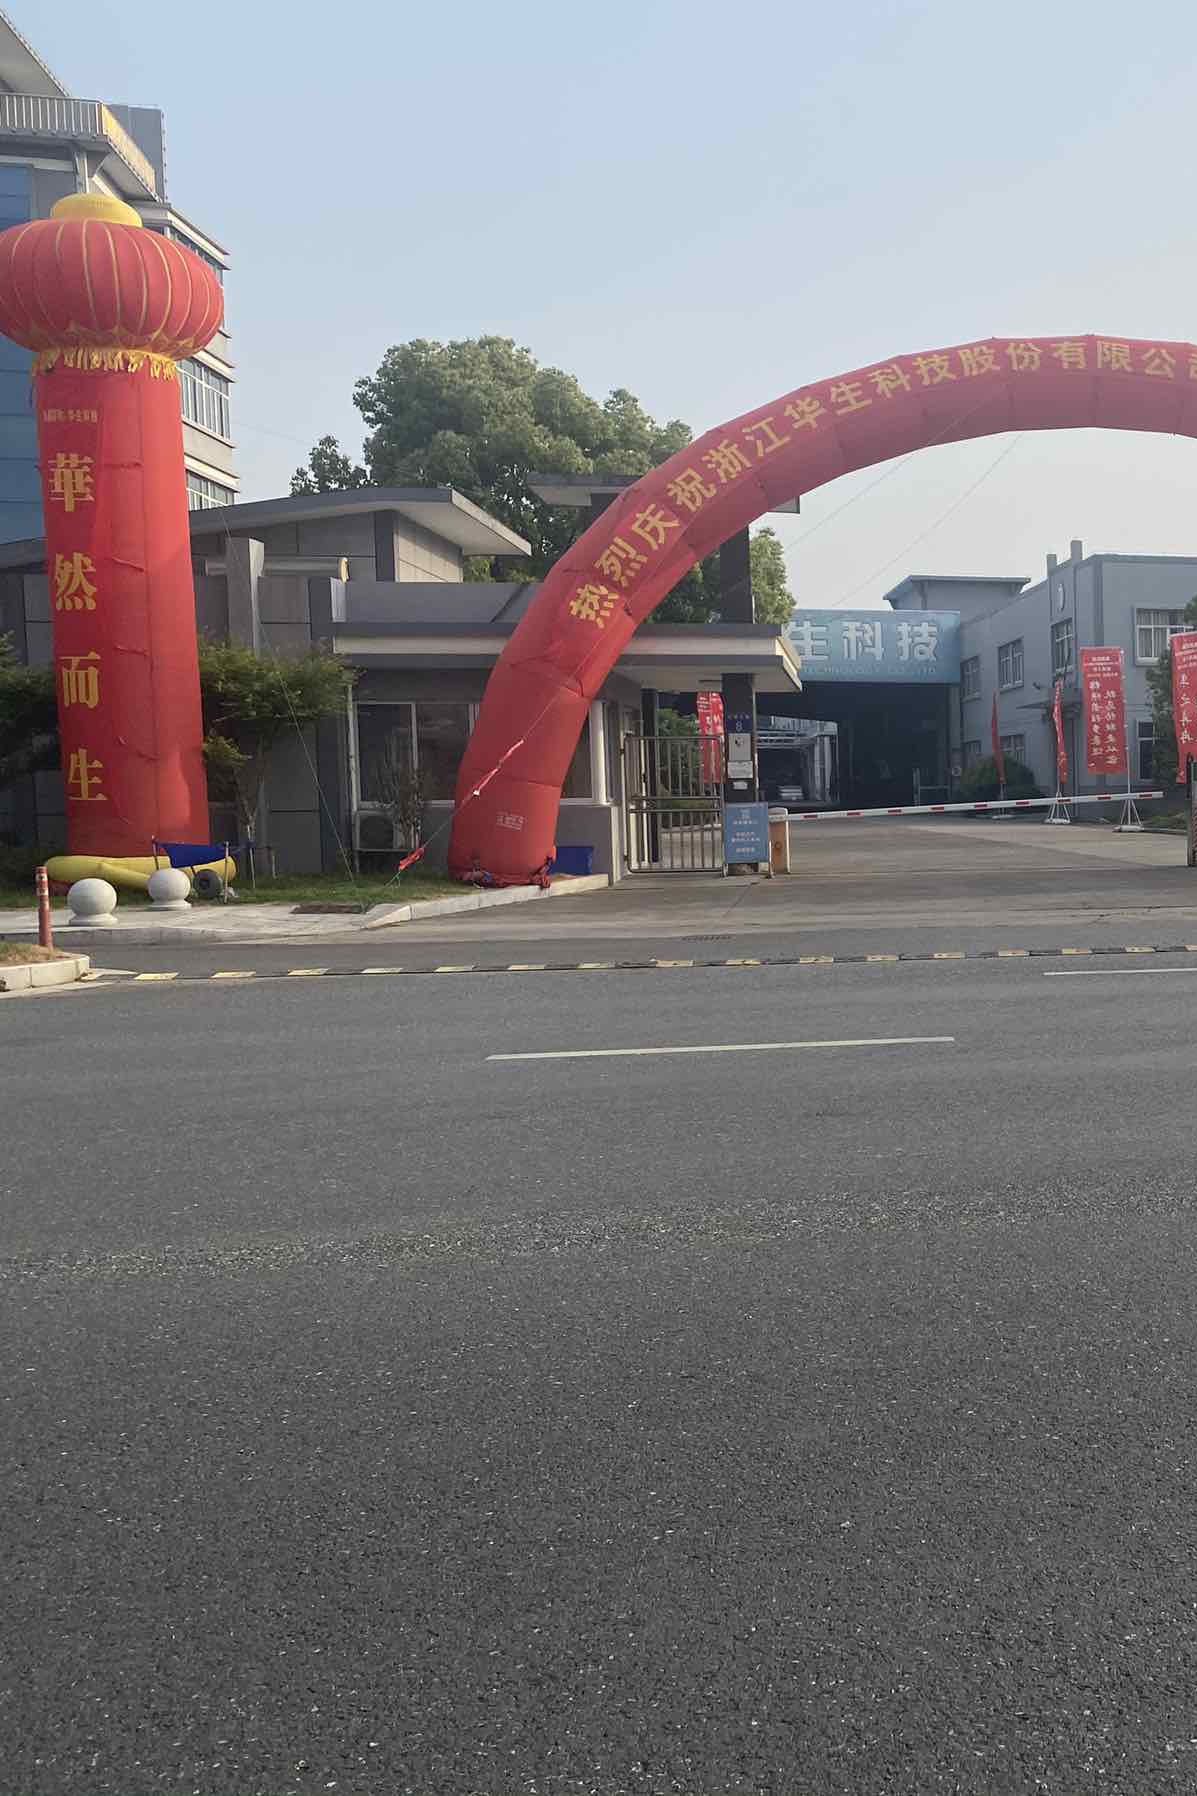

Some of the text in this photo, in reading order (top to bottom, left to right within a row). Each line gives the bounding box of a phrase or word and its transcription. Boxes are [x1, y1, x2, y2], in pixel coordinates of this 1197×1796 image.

[47, 452, 106, 802] 華然而生
[783, 620, 938, 662] 生科技
